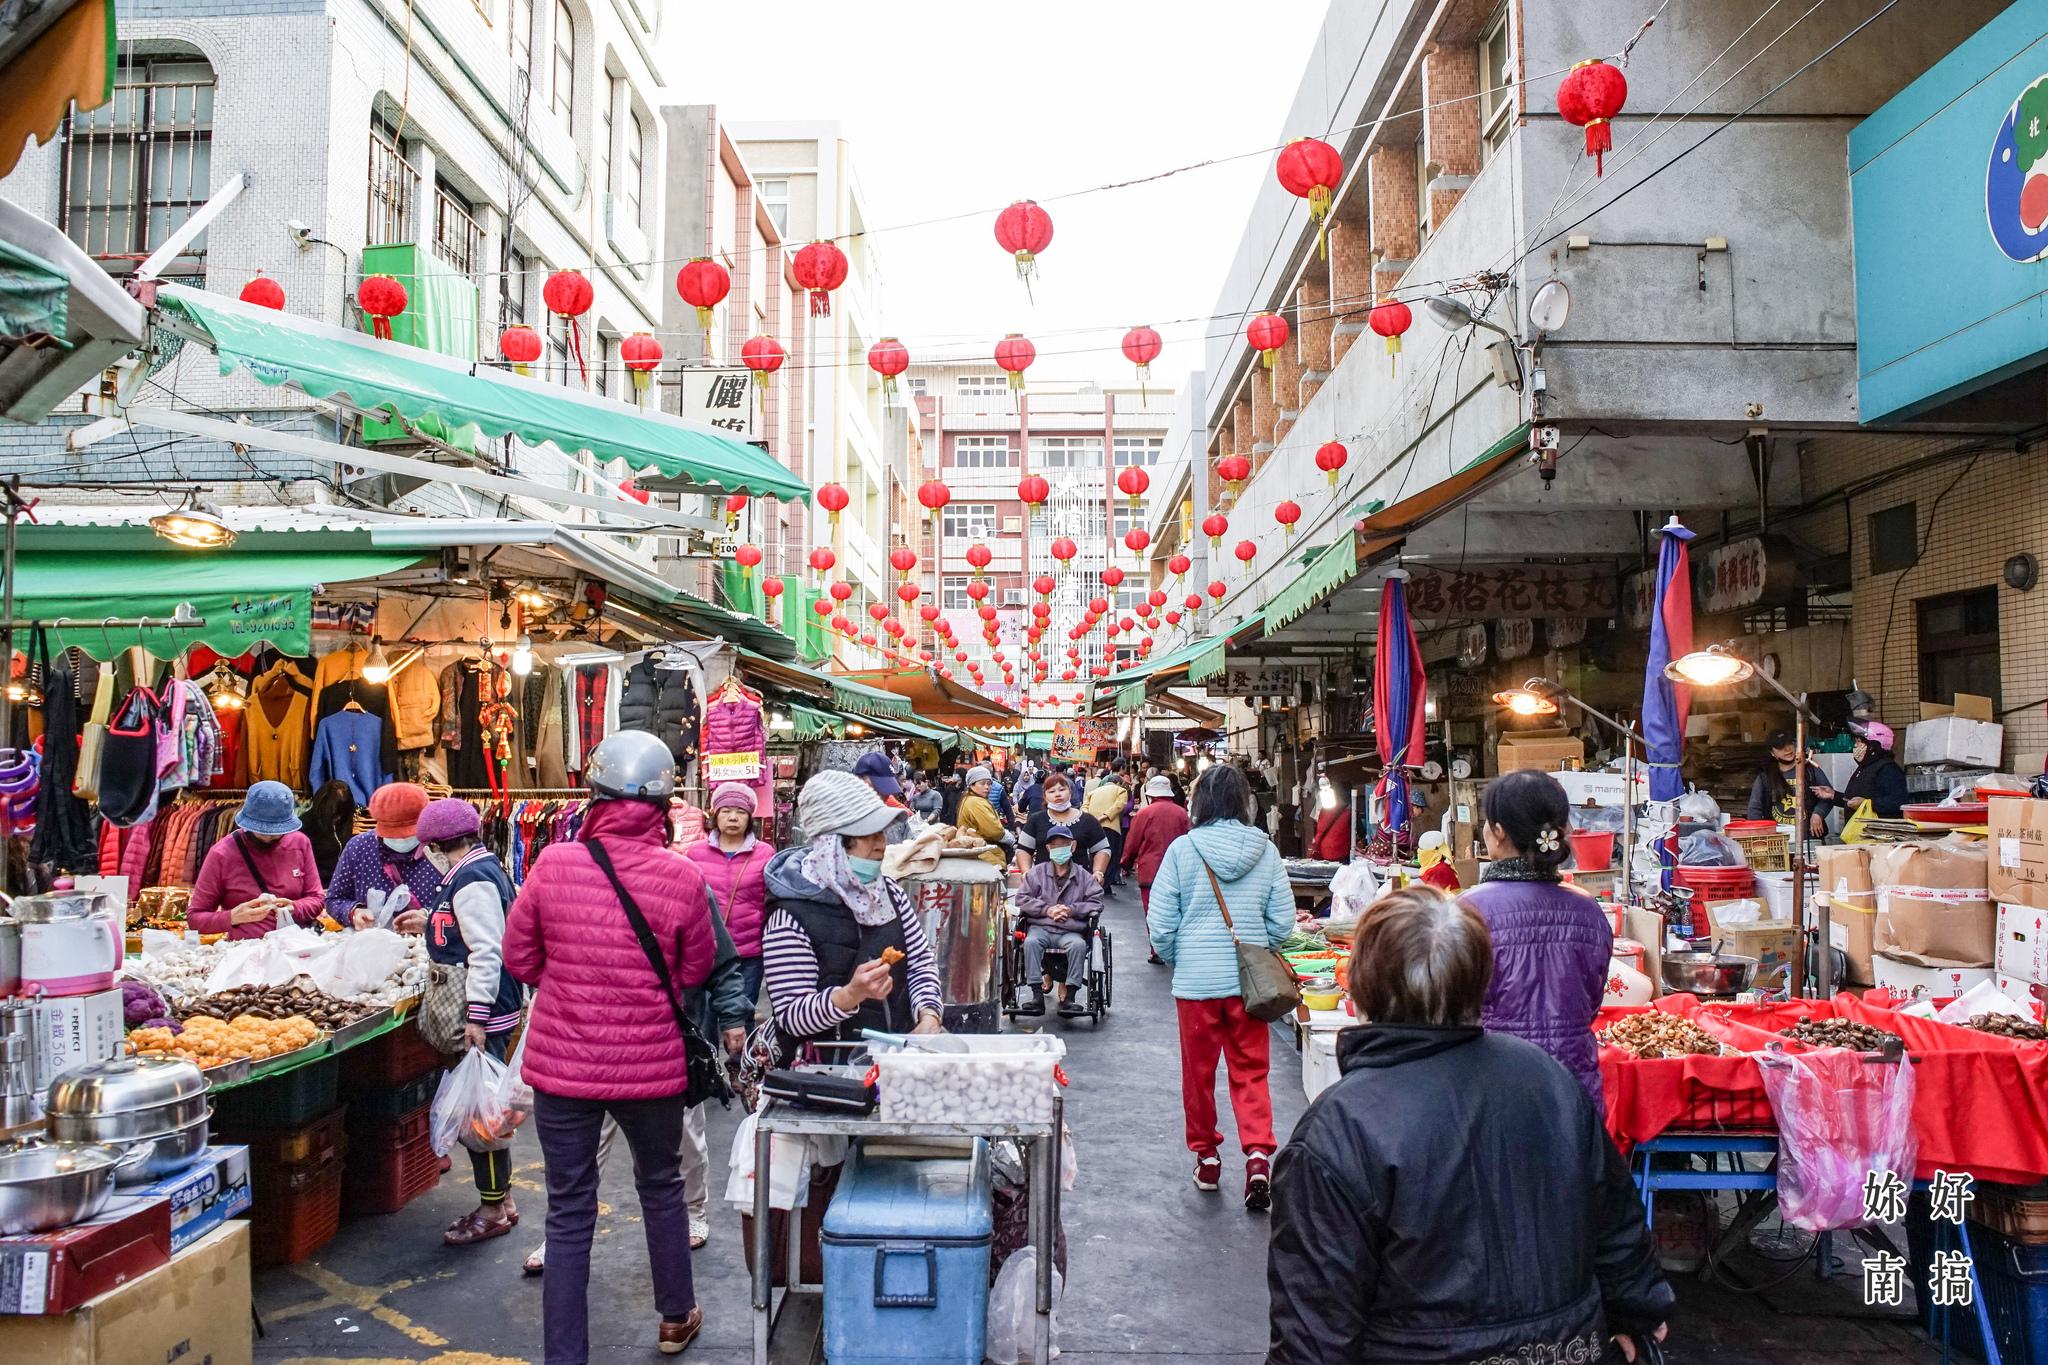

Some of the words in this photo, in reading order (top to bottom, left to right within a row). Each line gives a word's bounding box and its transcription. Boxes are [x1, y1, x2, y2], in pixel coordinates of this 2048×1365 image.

[746, 765, 757, 775] 5L
[2026, 867, 2035, 878] 16
[431, 911, 455, 947] T
